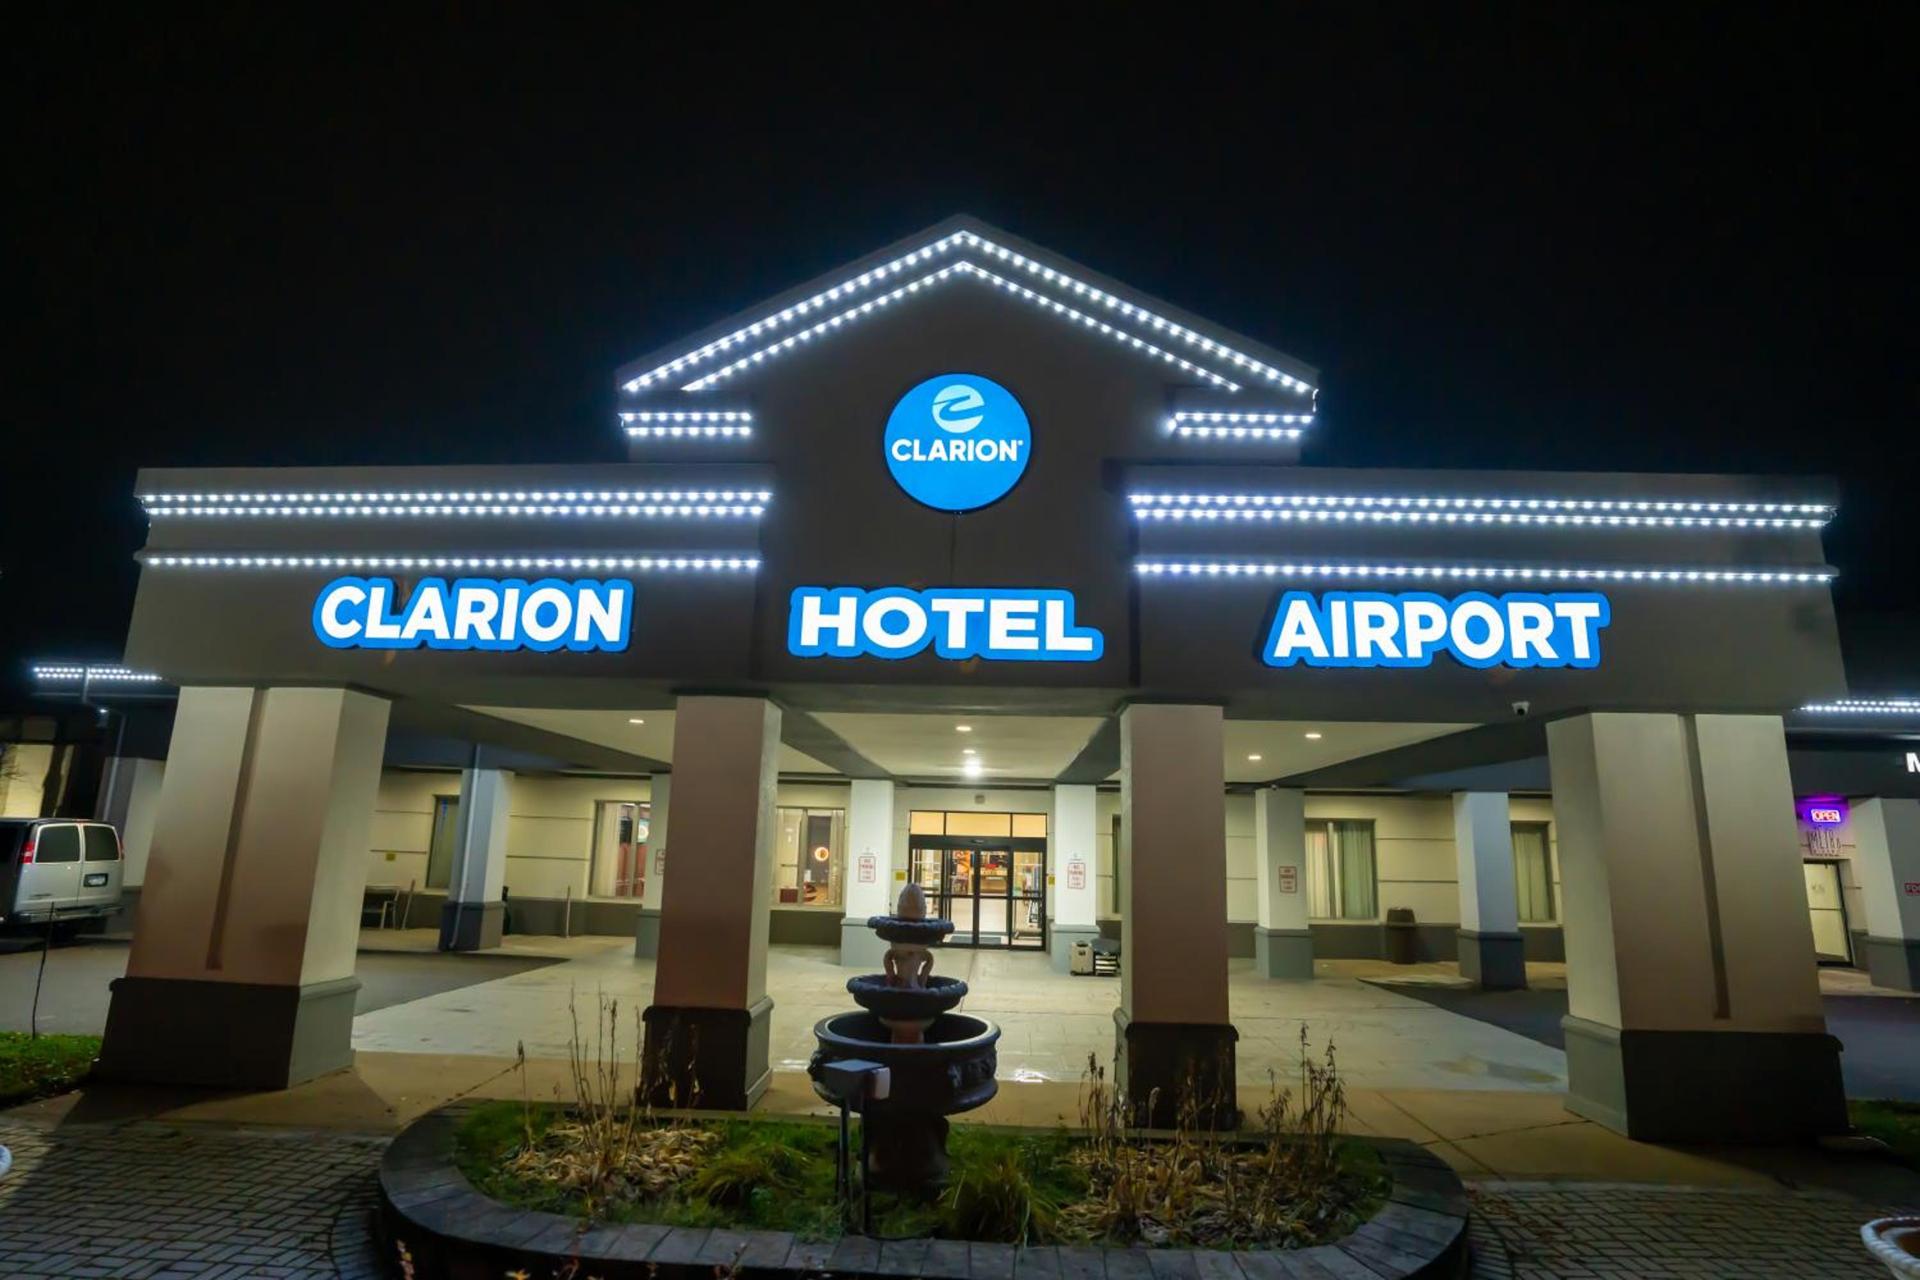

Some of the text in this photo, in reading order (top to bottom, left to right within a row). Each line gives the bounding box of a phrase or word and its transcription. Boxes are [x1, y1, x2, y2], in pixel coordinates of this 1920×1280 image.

[891, 438, 1018, 462] CLARION
[321, 585, 1600, 660] CLARION HOTEL AIRPORT
